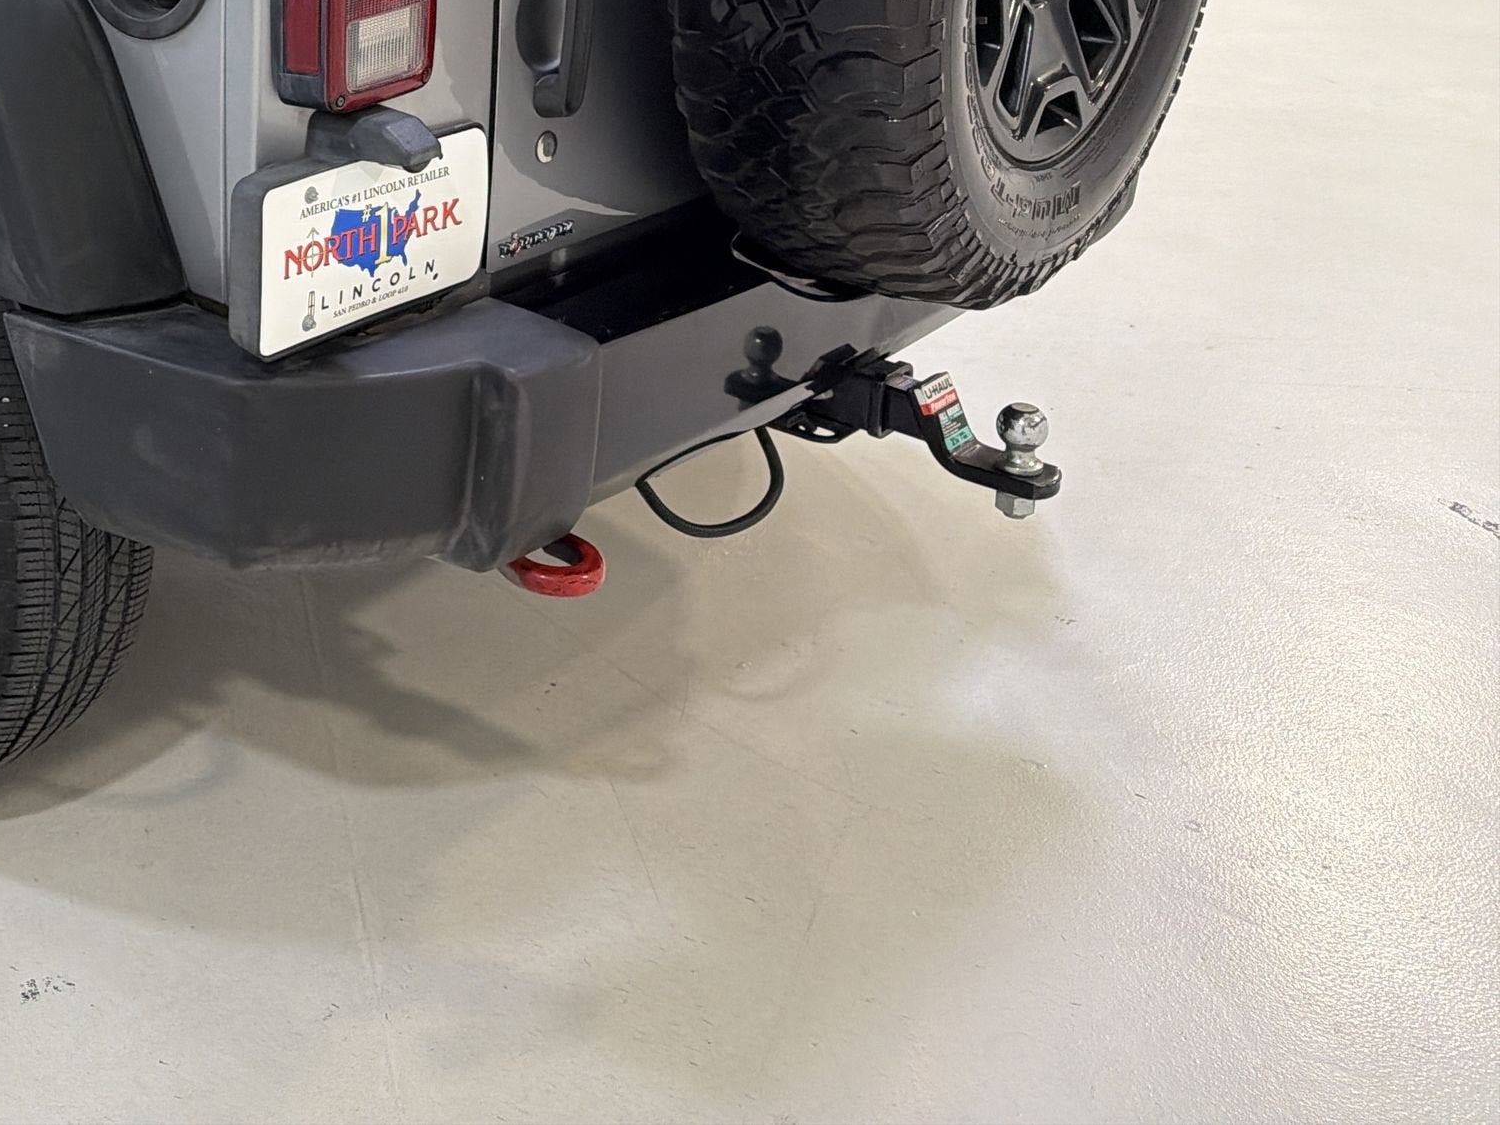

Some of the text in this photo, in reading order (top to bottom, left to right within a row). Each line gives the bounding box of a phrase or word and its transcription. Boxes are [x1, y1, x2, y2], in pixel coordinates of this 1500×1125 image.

[300, 166, 451, 219] AMERICA'S #1 LINCOLN RETAILER
[283, 222, 377, 281] NORTH
[390, 197, 462, 246] PARK
[320, 258, 436, 311] LINCOLN
[332, 306, 348, 319] SAN
[348, 298, 371, 314] PEDRO
[378, 289, 397, 302] LOOP
[924, 376, 954, 400] U-HAUL
